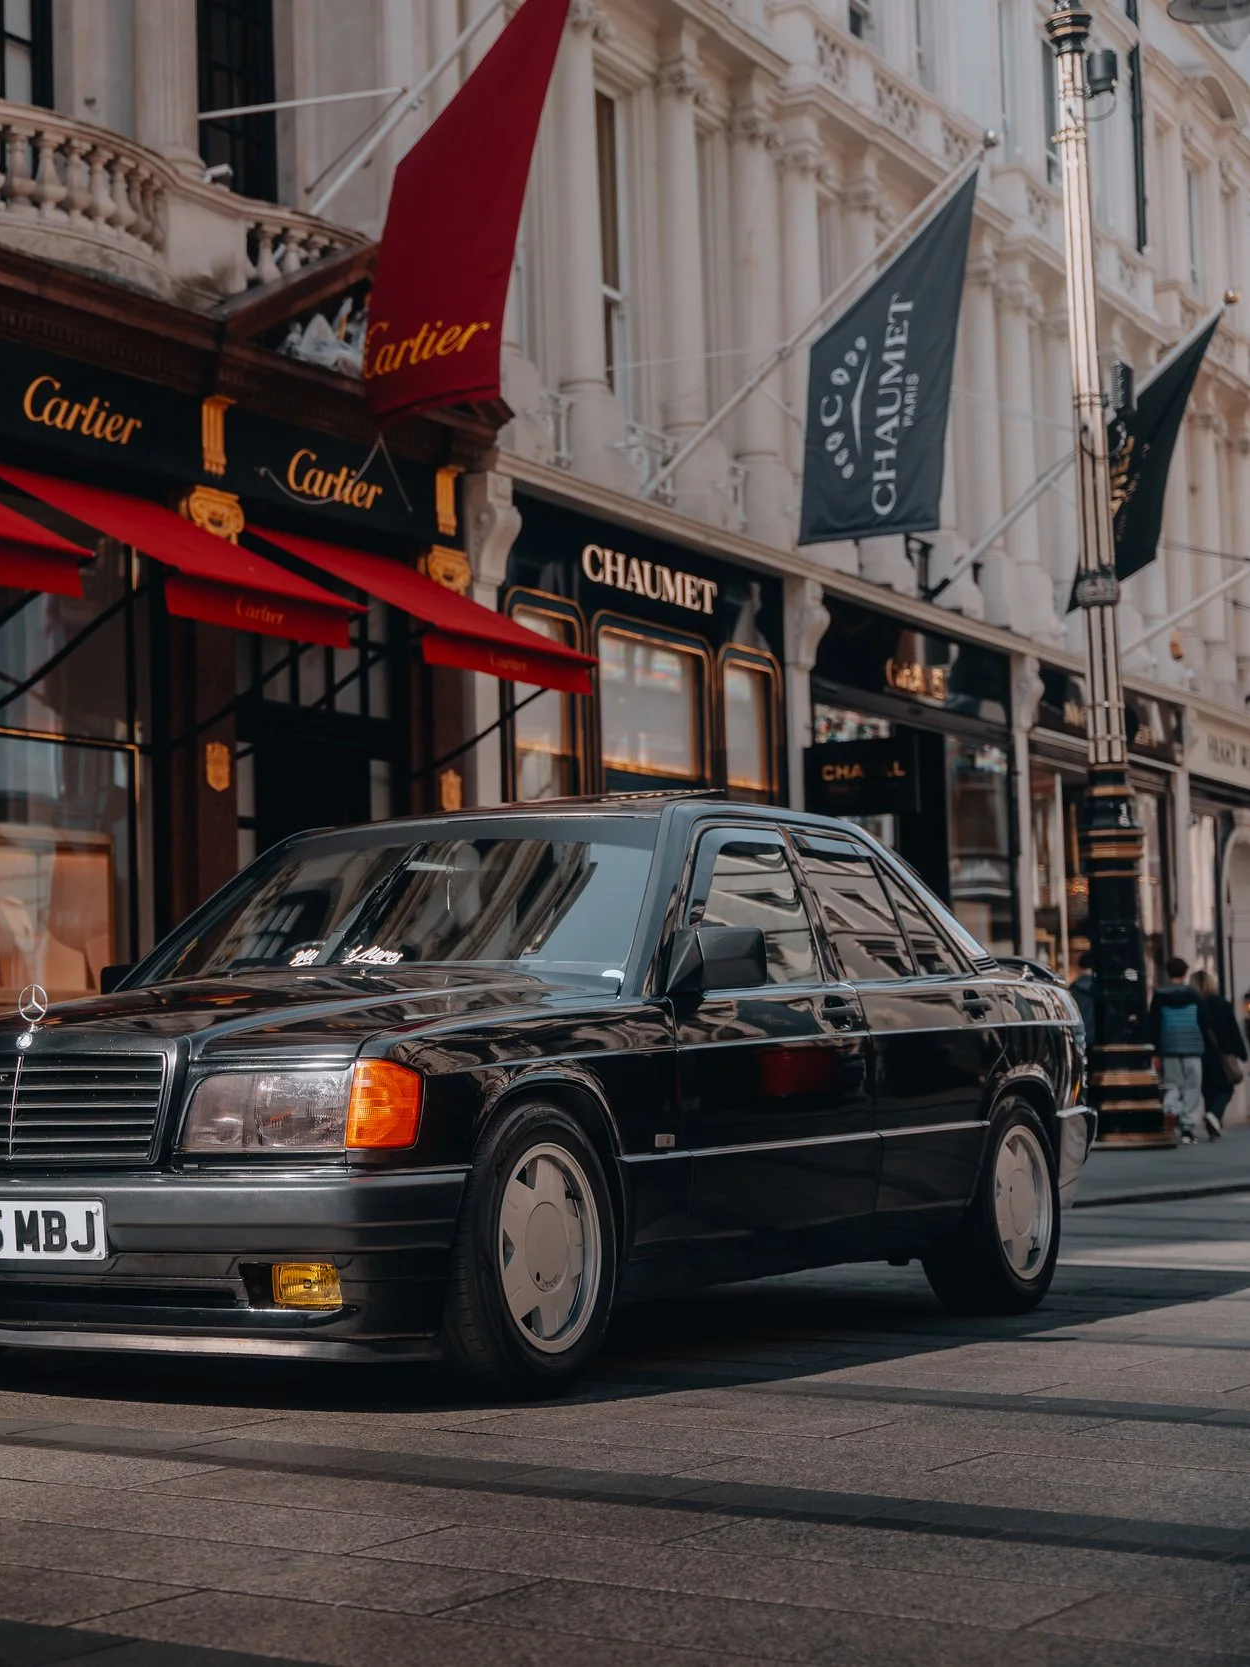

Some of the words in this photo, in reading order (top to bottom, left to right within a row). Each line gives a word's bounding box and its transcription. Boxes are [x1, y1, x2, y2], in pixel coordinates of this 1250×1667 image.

[363, 319, 490, 379] Cartier
[23, 374, 143, 445] Cartier
[871, 292, 914, 516] CHAUMET
[902, 372, 920, 427] PARIS
[287, 448, 383, 510] Cartier
[581, 543, 718, 615] CHAUMET
[822, 762, 906, 781] CHAL
[14, 1209, 96, 1253] MBJ
